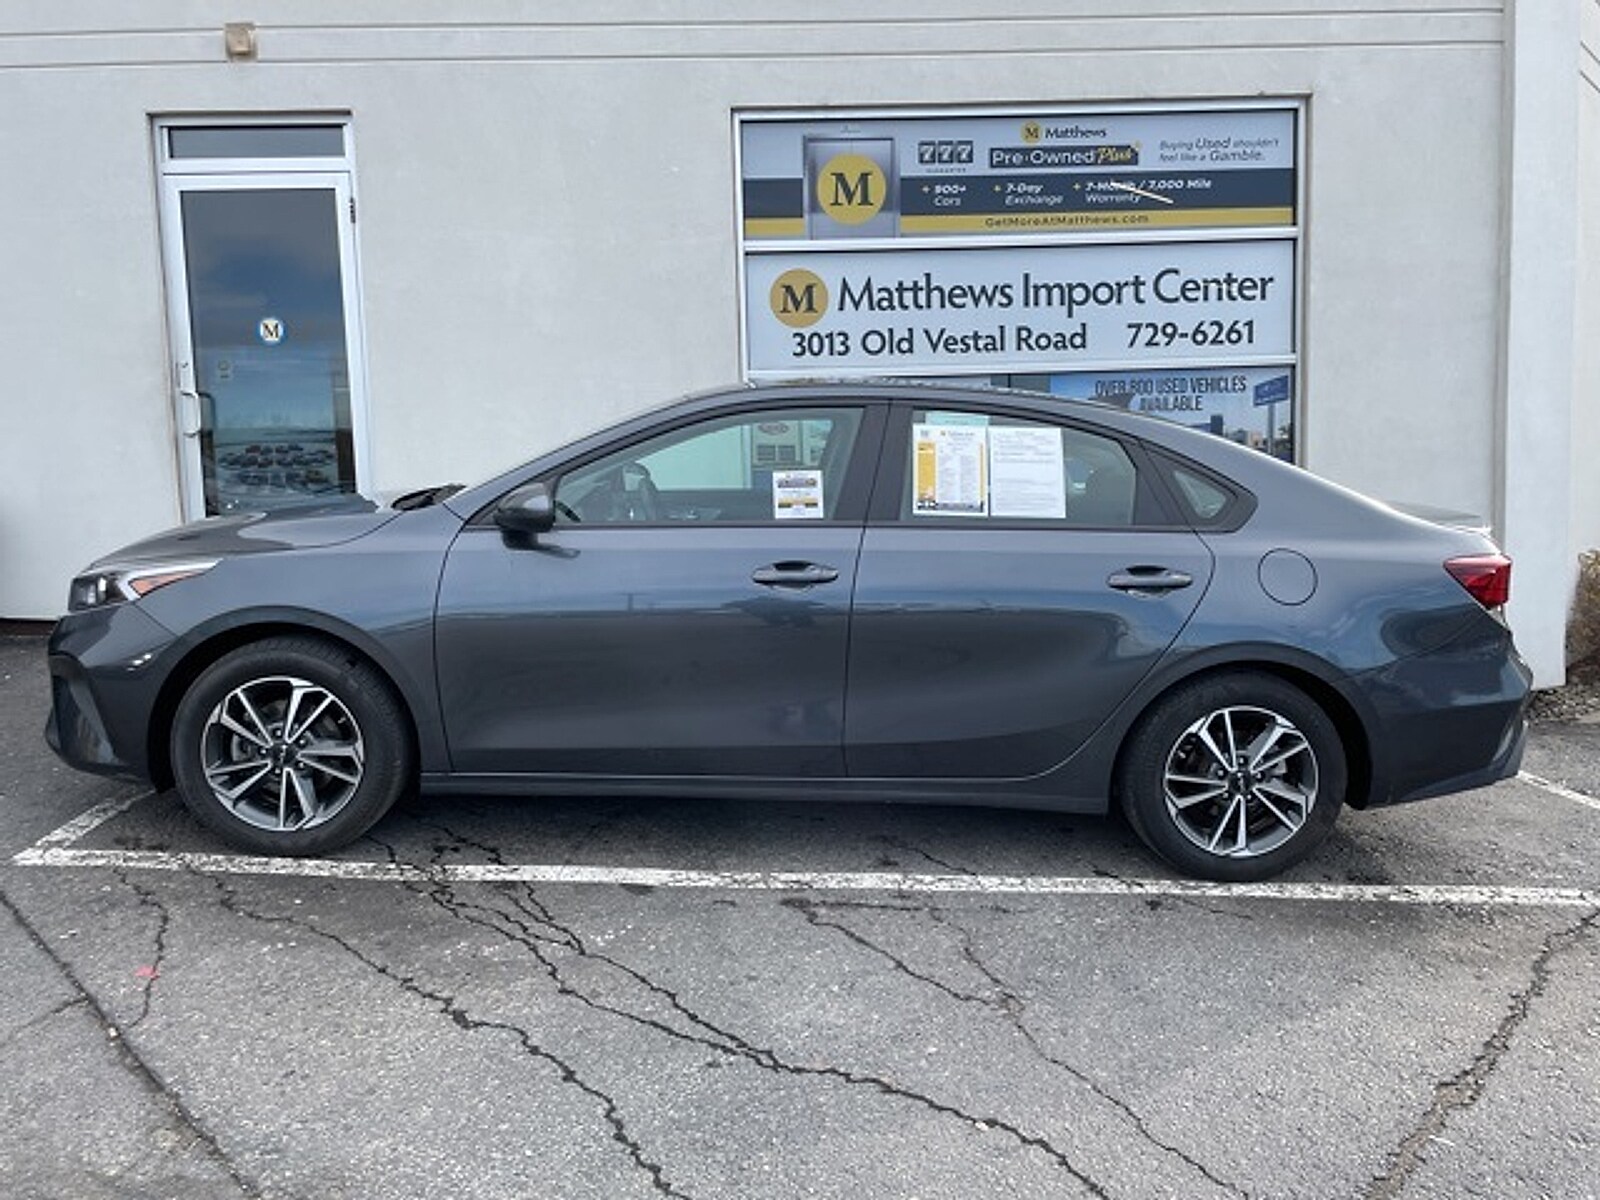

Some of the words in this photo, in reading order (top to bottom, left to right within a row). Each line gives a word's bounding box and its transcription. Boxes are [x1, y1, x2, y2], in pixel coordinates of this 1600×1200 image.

[1045, 124, 1107, 139] Matthews
[1195, 137, 1231, 150] Used
[830, 171, 874, 206] M
[780, 283, 818, 314] M
[838, 272, 1014, 311] Matthews
[1022, 272, 1146, 318] Import
[1152, 268, 1274, 303] Center
[792, 331, 850, 357] 3013
[861, 328, 914, 355] Old
[923, 325, 1005, 354] Vestal
[1015, 323, 1087, 351] Road
[1126, 319, 1254, 348] 729-6261
[1095, 380, 1126, 396] OVER
[1156, 378, 1187, 393] USED
[1190, 376, 1247, 393] VEHICLES
